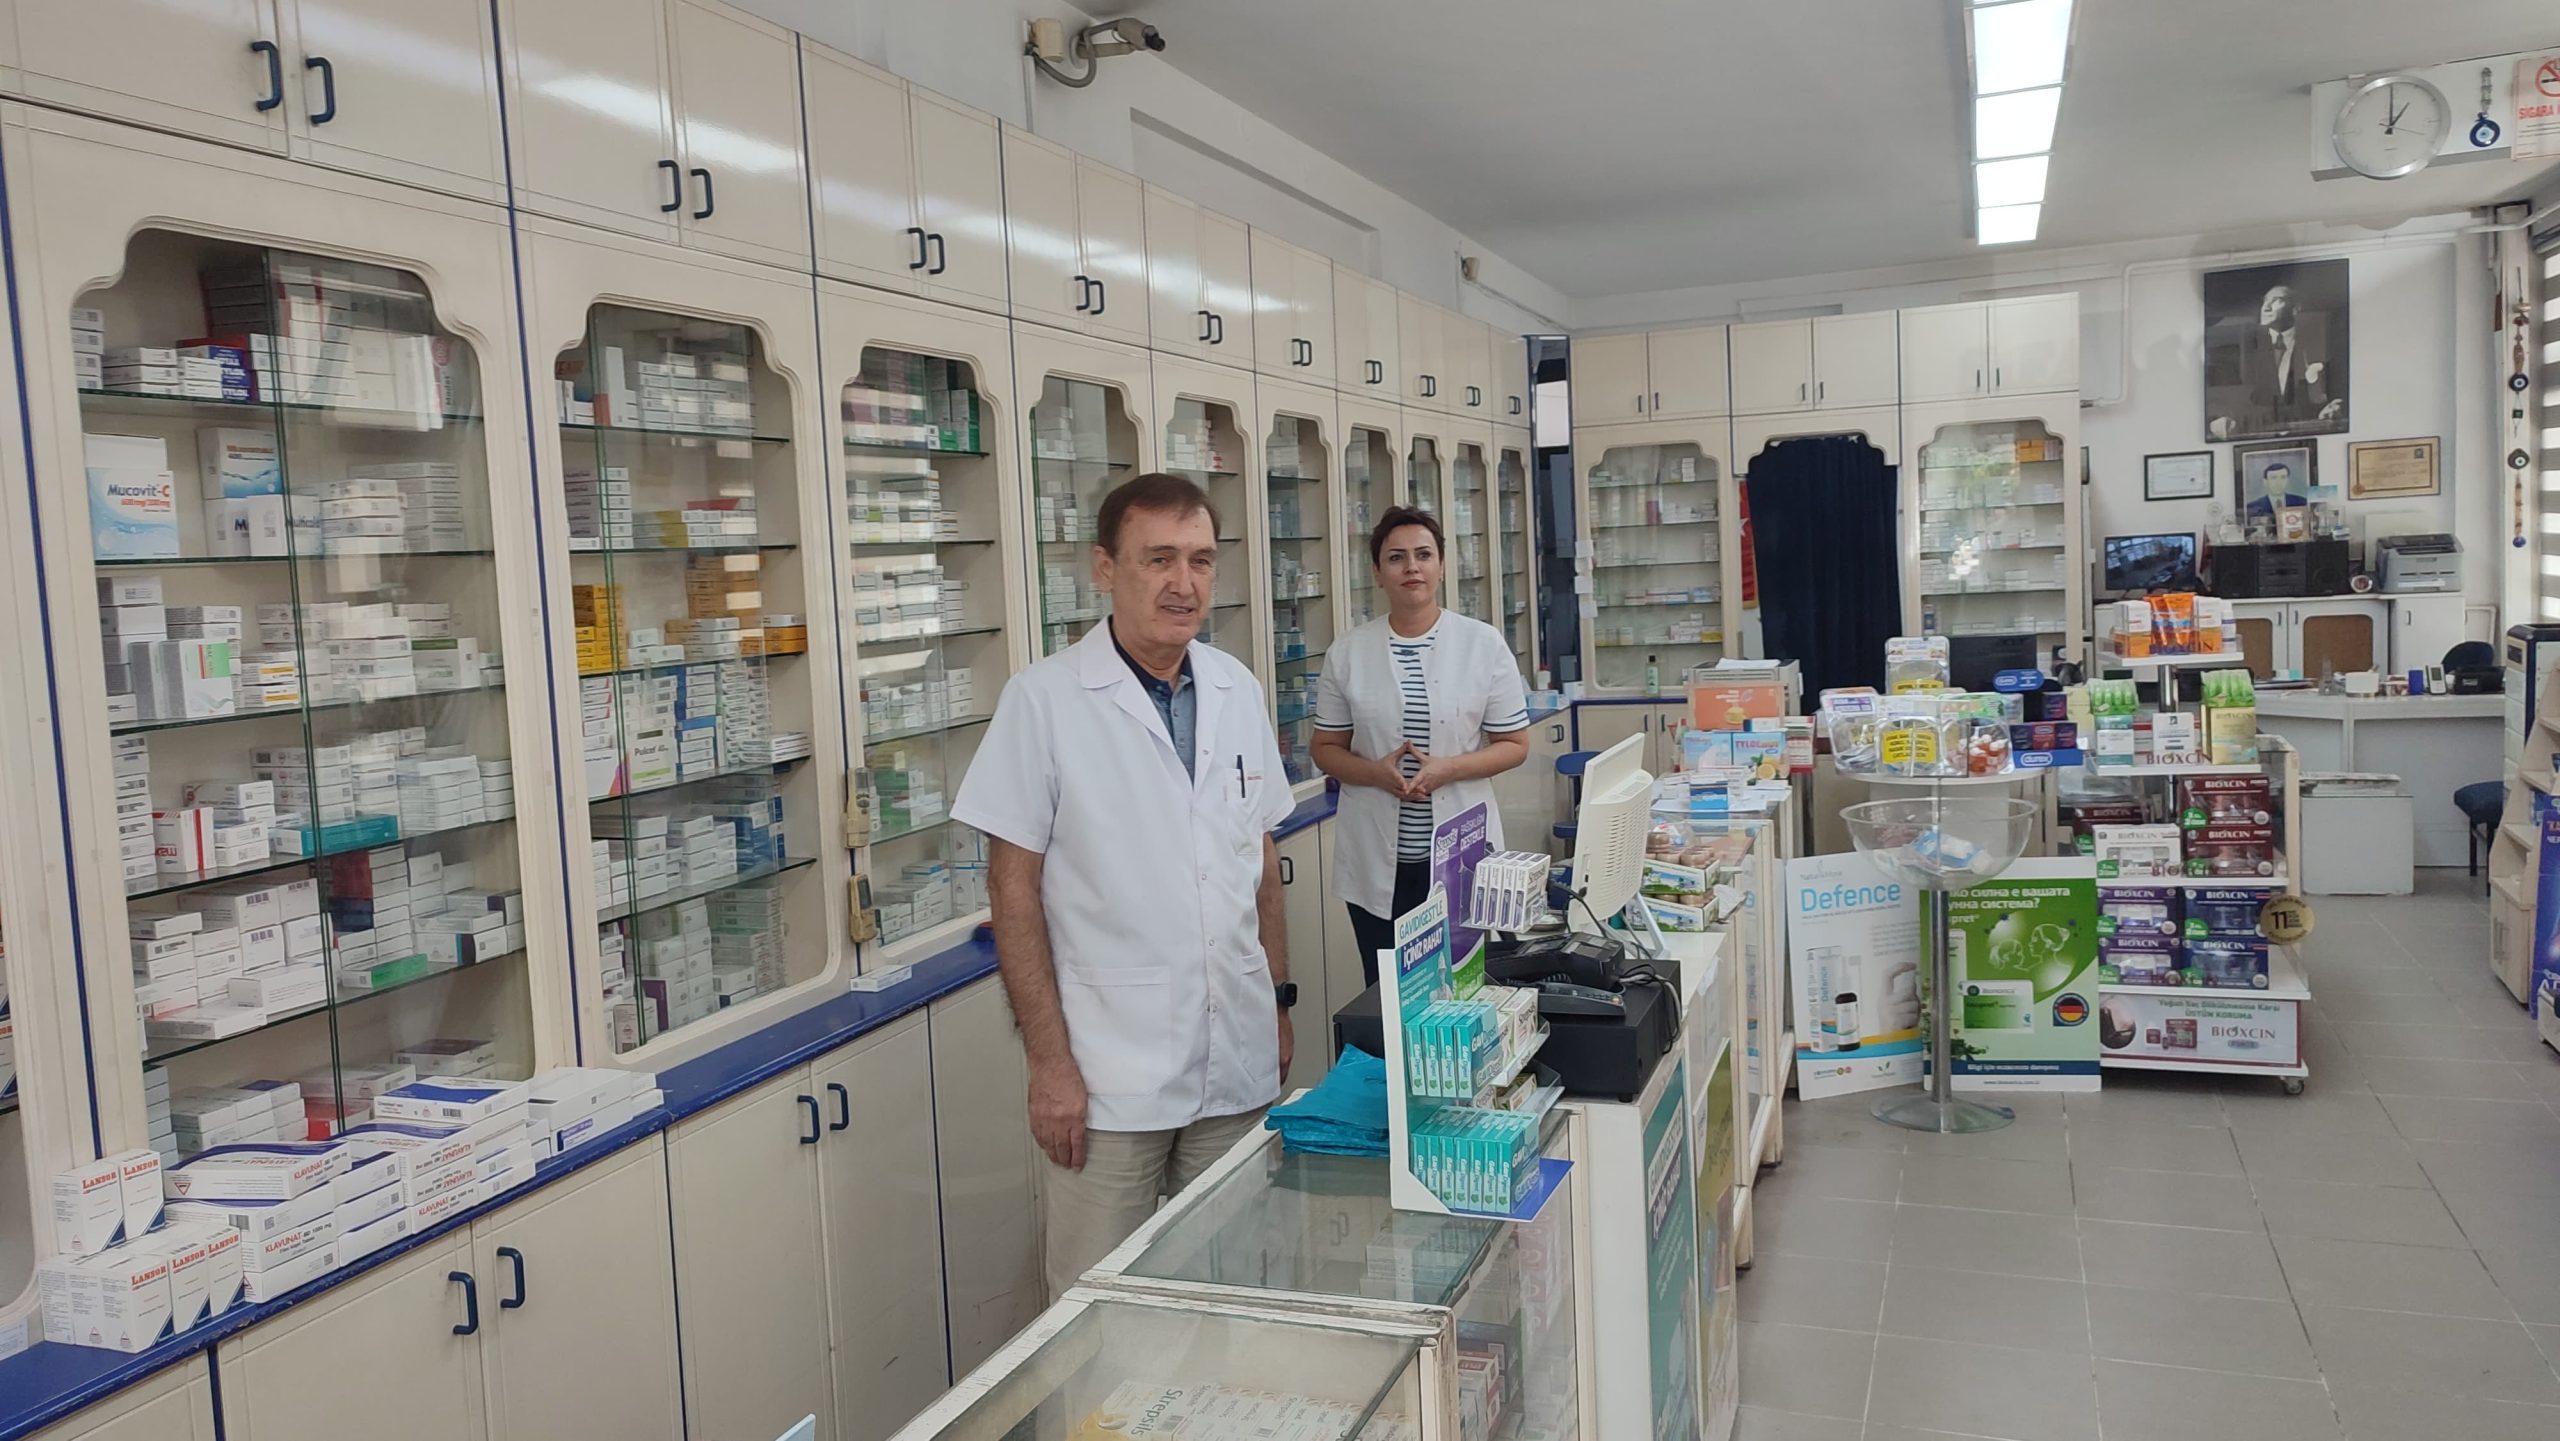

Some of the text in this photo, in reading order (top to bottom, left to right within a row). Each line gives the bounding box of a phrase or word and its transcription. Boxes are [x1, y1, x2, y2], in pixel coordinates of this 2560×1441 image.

[1801, 883, 1901, 912] Defence
[2211, 1026, 2276, 1039] BIOXCIN
[123, 1159, 159, 1176] LANSOR
[294, 1159, 324, 1180] KLAVUNAT
[82, 1171, 118, 1189] LANSOR
[419, 1197, 449, 1216] KLAVUNAT
[207, 1234, 239, 1253] LANSOR
[265, 1232, 302, 1254] KLAVUNAT
[172, 1249, 205, 1269] LANSOR
[131, 1265, 167, 1286] LANSOR
[1131, 1388, 1183, 1436] Strepsils
